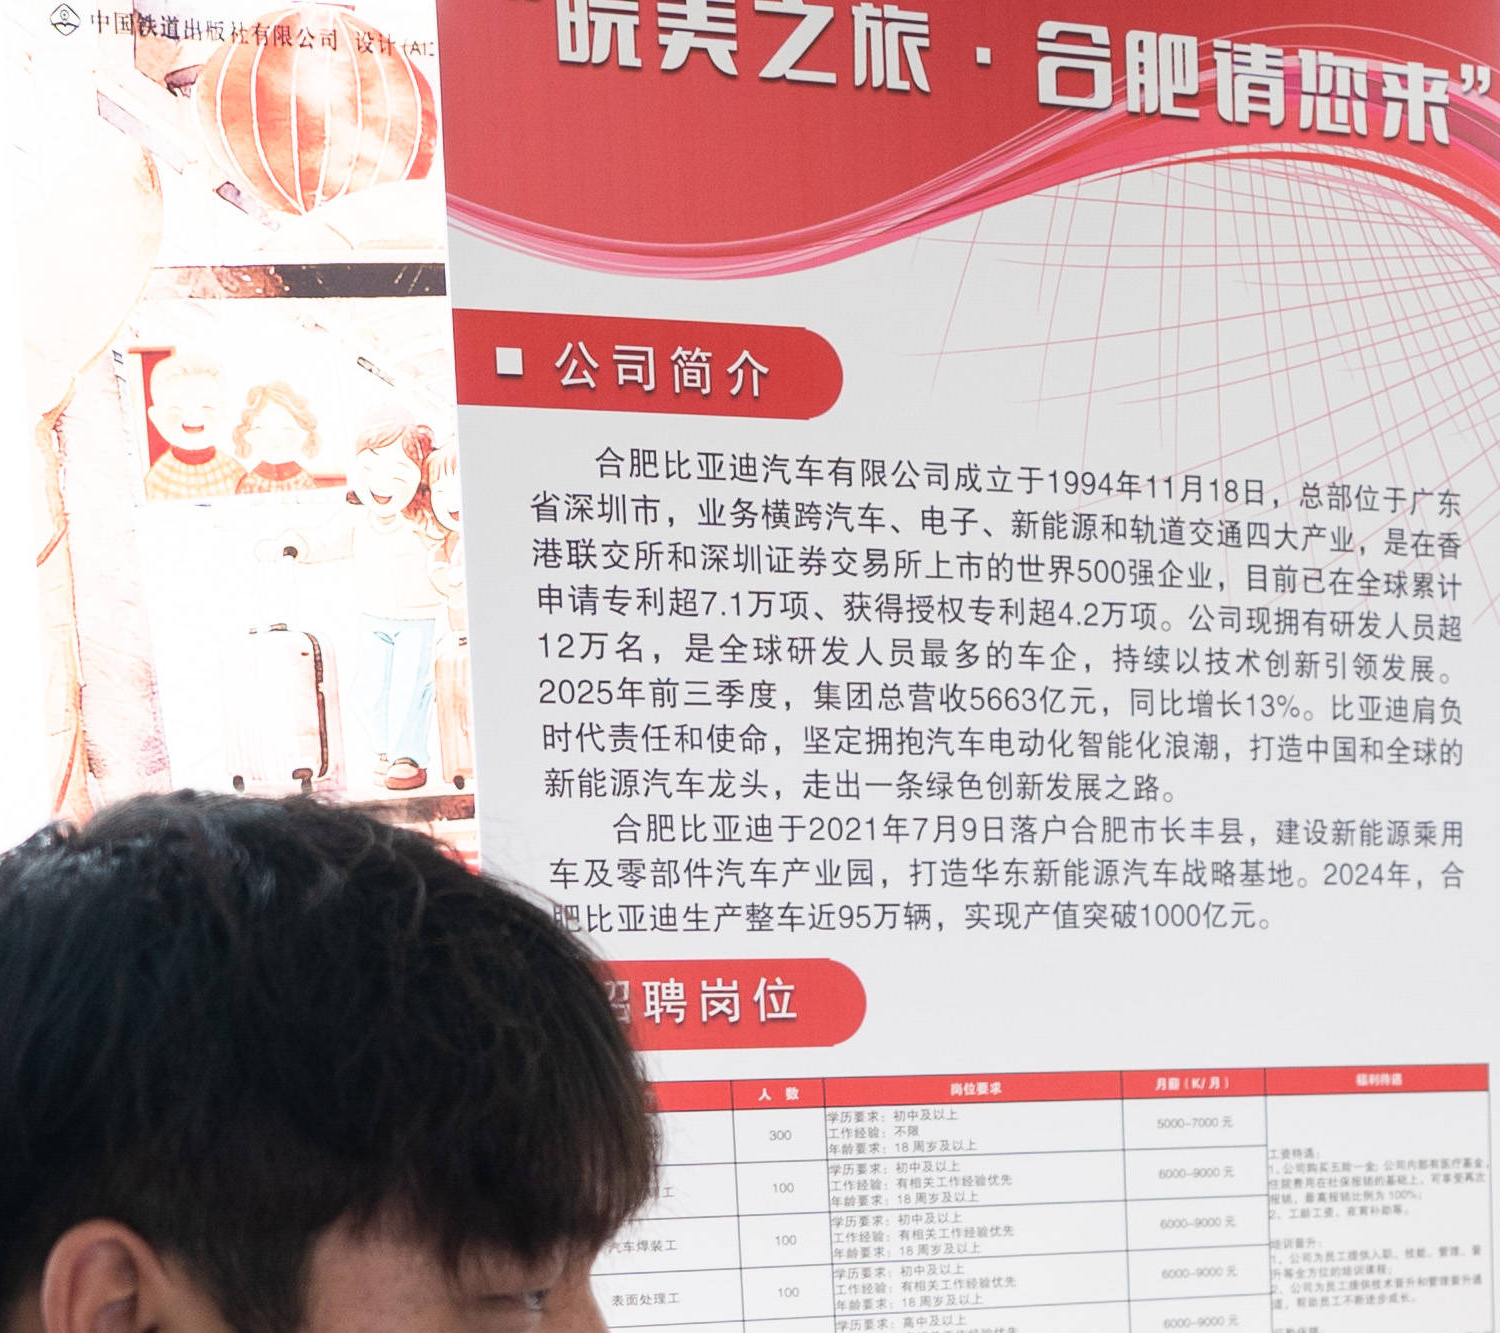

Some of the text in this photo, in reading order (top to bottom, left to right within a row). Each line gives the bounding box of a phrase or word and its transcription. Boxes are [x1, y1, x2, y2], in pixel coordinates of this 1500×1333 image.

[91, 9, 339, 52] 中国铁道出版社有限公司
[554, 339, 772, 399] 公司简介
[595, 446, 1462, 519] 合肥比亚迪汽车有限公司成立于1994年11月18日，总部位于广东
[530, 491, 1462, 561] 省深圳市，业务横跨汽车、电子、新能源和轨道交通四大产业，是在香
[532, 538, 1462, 602] 港联交所和深圳证券交易所上市的世界500强企业，目前已在全球累计
[537, 584, 1462, 643] 申请专利超7.1万项、获得授权专利超4.2万项。公司现拥有研发人员超
[538, 631, 1452, 685] 12万名，是全球研发人员最多的车企，持续以技术创新引领发展。
[538, 676, 1462, 726] 2025年前三季度，集团总营收5663亿元，同比增长13%。比亚迪肩负
[542, 722, 1464, 767] 时代责任和使命，坚定拥抱汽车电动化智能化浪潮，打造中国和全球的
[544, 768, 1174, 804] 新能源汽车龙头，走出一条绿色创新发展之路。
[613, 813, 1464, 848] 合肥比亚迪于2021年7月9日落户合肥市长丰县，建设新能源乘用
[550, 858, 1465, 890] 车及零部件汽车产业园，打造华东新能源汽车战略基地。2024年，合
[553, 901, 1270, 933] 肥比亚迪生产整车近95万辆，实现产值突破1000亿元。
[950, 1082, 1002, 1096] 岗位要求
[769, 1130, 791, 1141] 300
[773, 1183, 794, 1193] 100
[776, 1235, 797, 1246] 100
[612, 1293, 680, 1306] 表面处理工
[778, 1288, 799, 1298] 100
